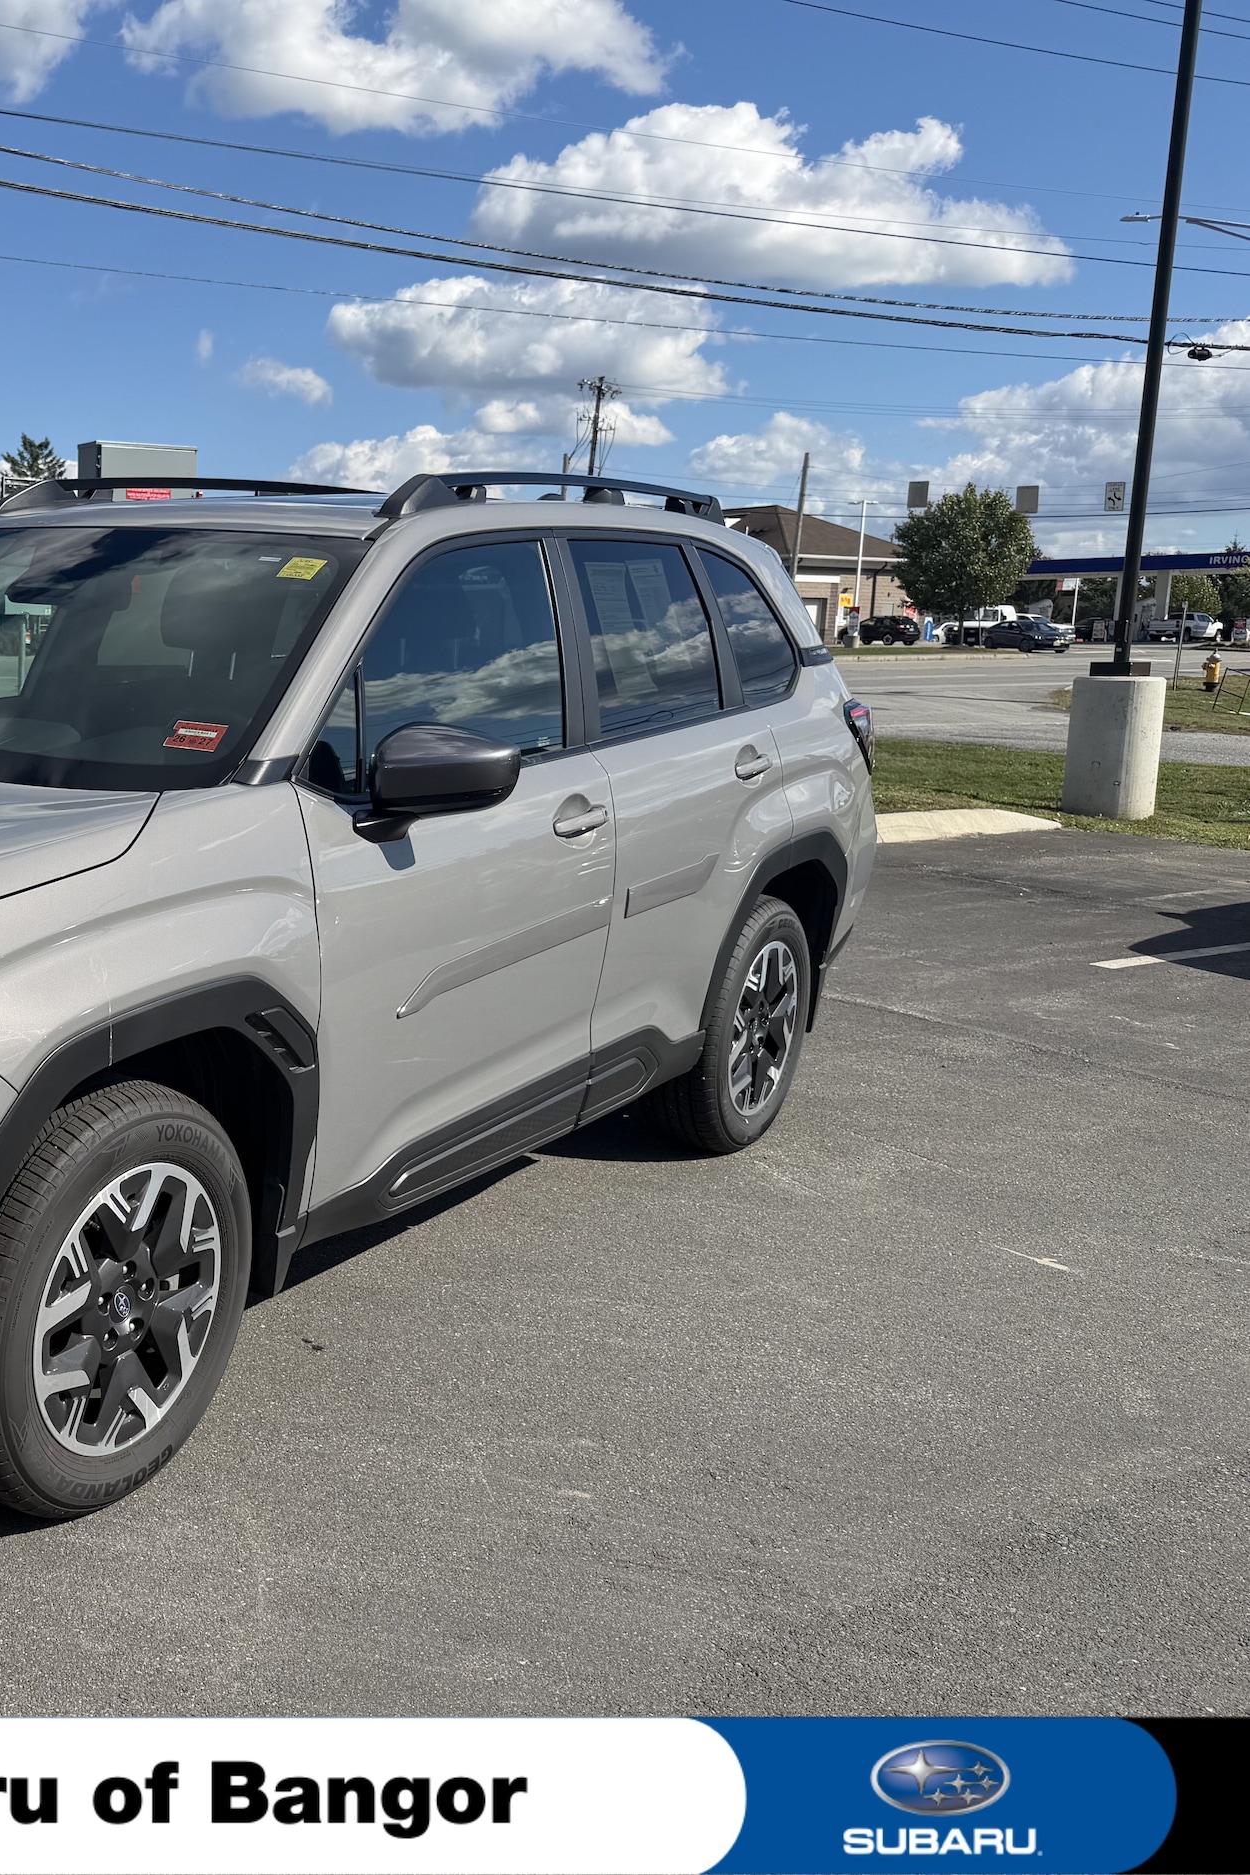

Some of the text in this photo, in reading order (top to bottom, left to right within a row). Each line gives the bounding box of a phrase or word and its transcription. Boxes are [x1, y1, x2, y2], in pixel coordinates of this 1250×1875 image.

[1208, 555, 1250, 565] IRVING
[172, 735, 214, 746] 26 27
[156, 1123, 227, 1171] YOKOHAMA
[43, 1443, 173, 1500] GEOLANDAR
